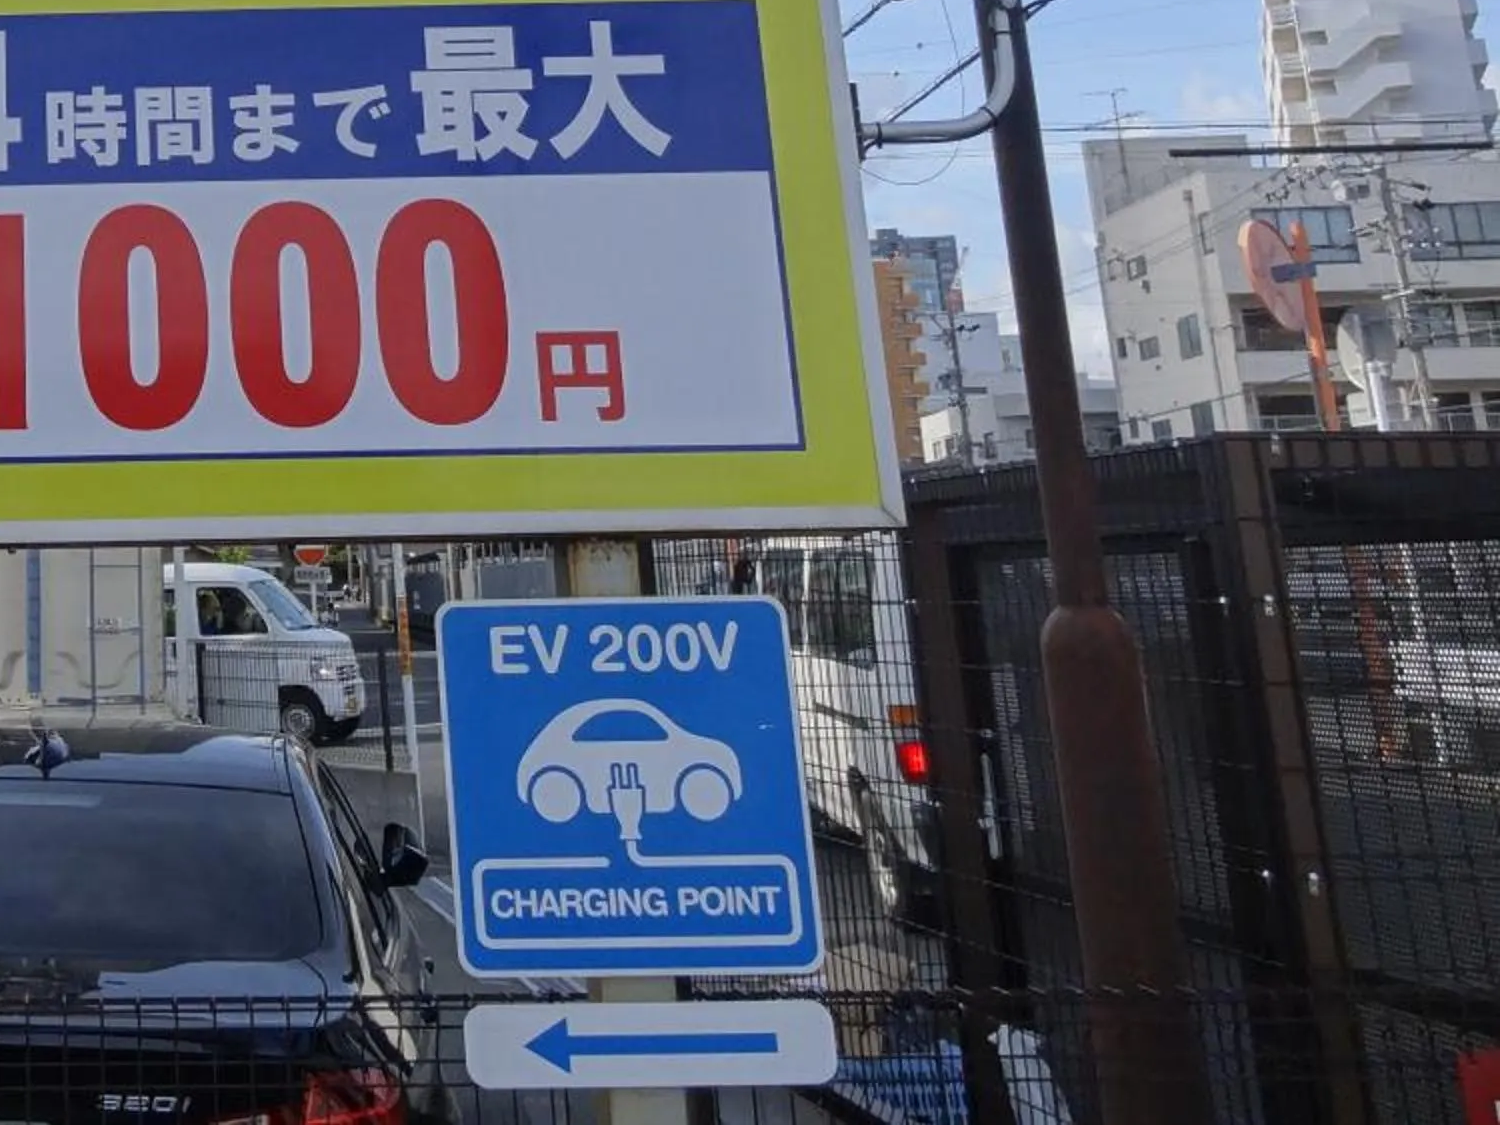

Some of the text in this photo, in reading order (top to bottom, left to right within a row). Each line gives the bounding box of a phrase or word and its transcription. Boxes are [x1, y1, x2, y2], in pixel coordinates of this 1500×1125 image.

[489, 620, 739, 675] EV 200V
[490, 884, 781, 919] CHARGING POINT
